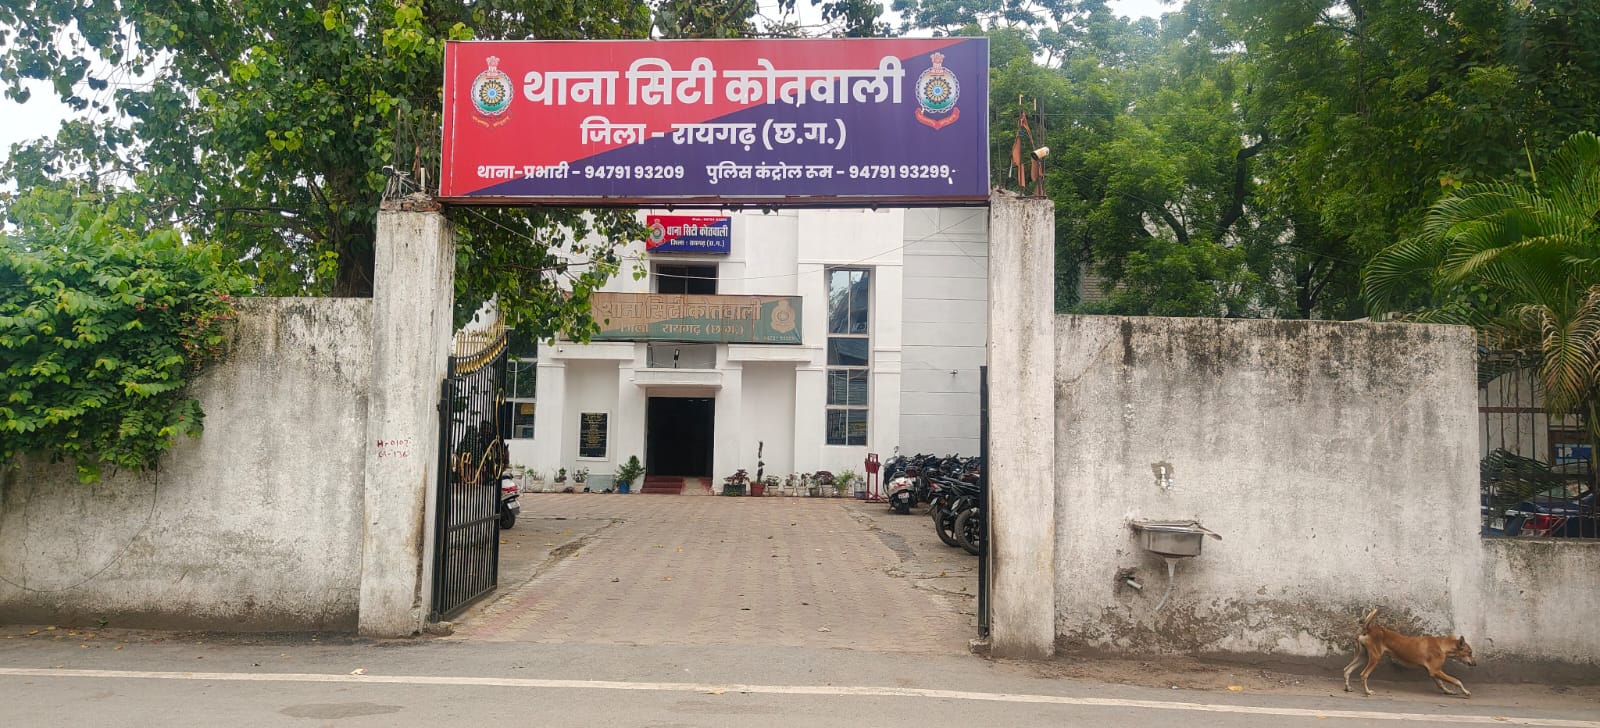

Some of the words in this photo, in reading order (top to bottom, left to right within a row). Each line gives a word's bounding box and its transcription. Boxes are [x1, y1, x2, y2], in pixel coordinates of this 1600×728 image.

[523, 71, 619, 106] थाना
[625, 57, 716, 105] सिटी
[723, 55, 905, 105] कोतवाली
[580, 115, 646, 145] जिला
[671, 122, 757, 151] रायगढ़
[762, 118, 847, 150] (छ.ग.)
[477, 160, 569, 180] थाना-प्रभारी
[584, 165, 631, 179] 94791
[634, 165, 685, 179] 93209
[706, 160, 752, 184] पुलिस
[755, 161, 803, 181] कंट्रोल
[805, 165, 833, 179] रूम
[849, 165, 896, 179] 94791
[899, 165, 950, 179] 93299
